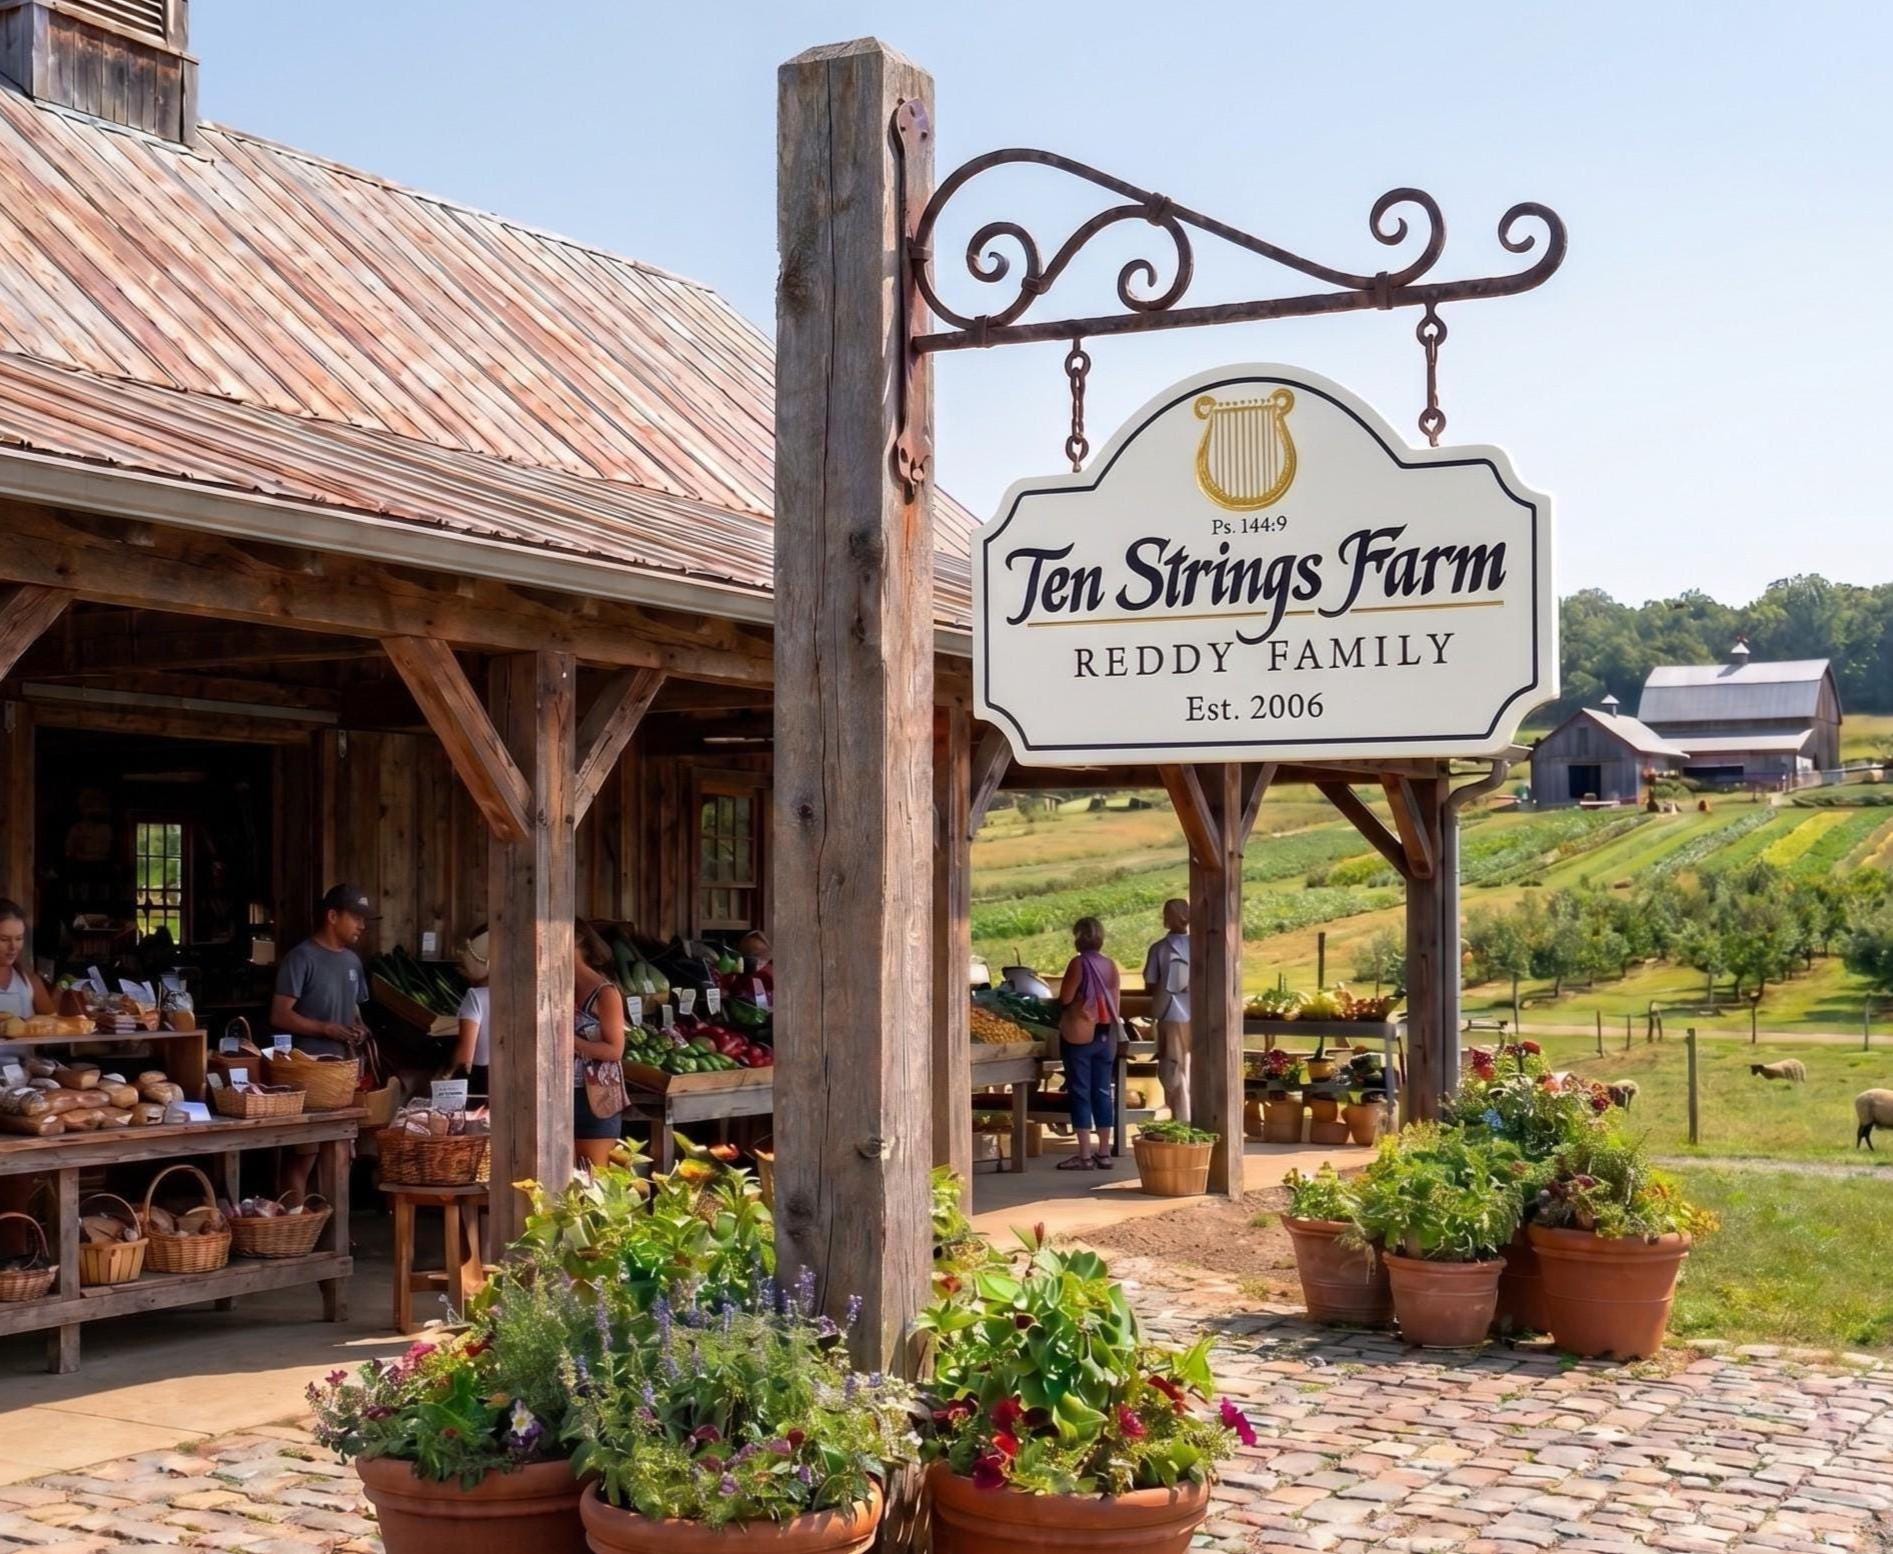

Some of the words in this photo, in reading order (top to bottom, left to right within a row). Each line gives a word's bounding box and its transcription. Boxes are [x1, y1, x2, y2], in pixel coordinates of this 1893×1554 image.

[1212, 520, 1235, 535] Ps.
[1242, 516, 1287, 534] 144:9
[1005, 543, 1105, 626] Ten
[1116, 537, 1322, 645] Strings
[1318, 524, 1506, 618] Farm
[1075, 642, 1234, 677] REDDY
[1268, 633, 1454, 672] FAMILY
[1186, 696, 1238, 721] Est.
[1251, 693, 1323, 720] 2006
